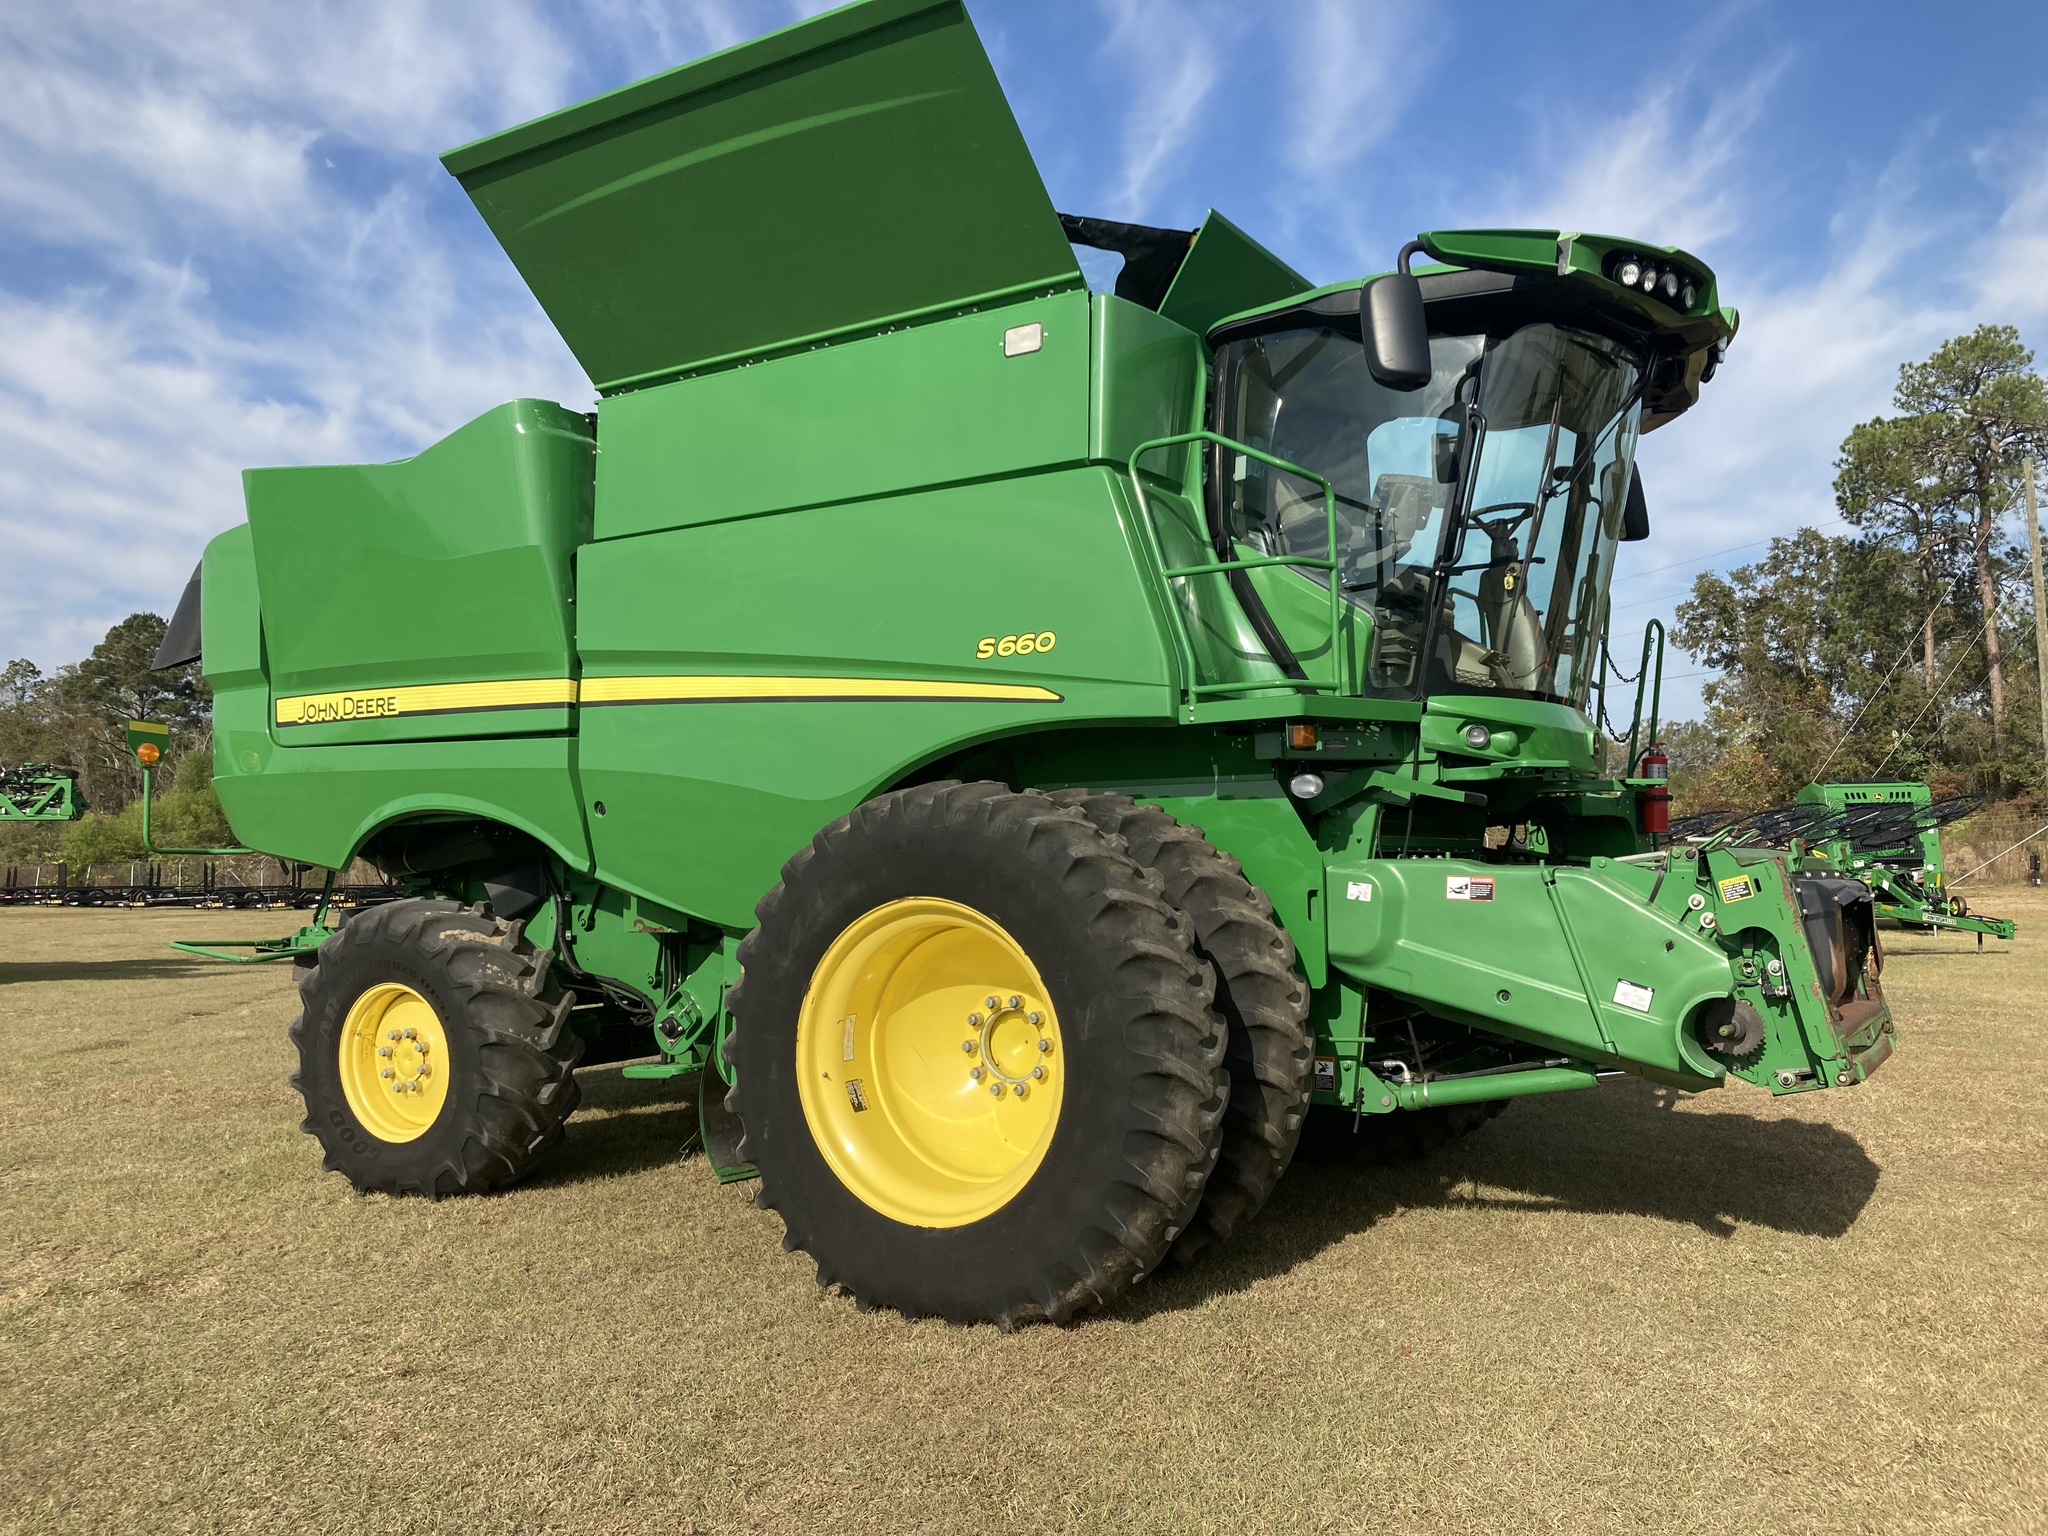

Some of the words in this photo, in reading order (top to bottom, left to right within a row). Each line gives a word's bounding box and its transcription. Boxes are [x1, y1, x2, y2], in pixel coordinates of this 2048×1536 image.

[976, 630, 1056, 660] S660
[297, 701, 339, 722] JOHN
[343, 696, 397, 717] DEERE
